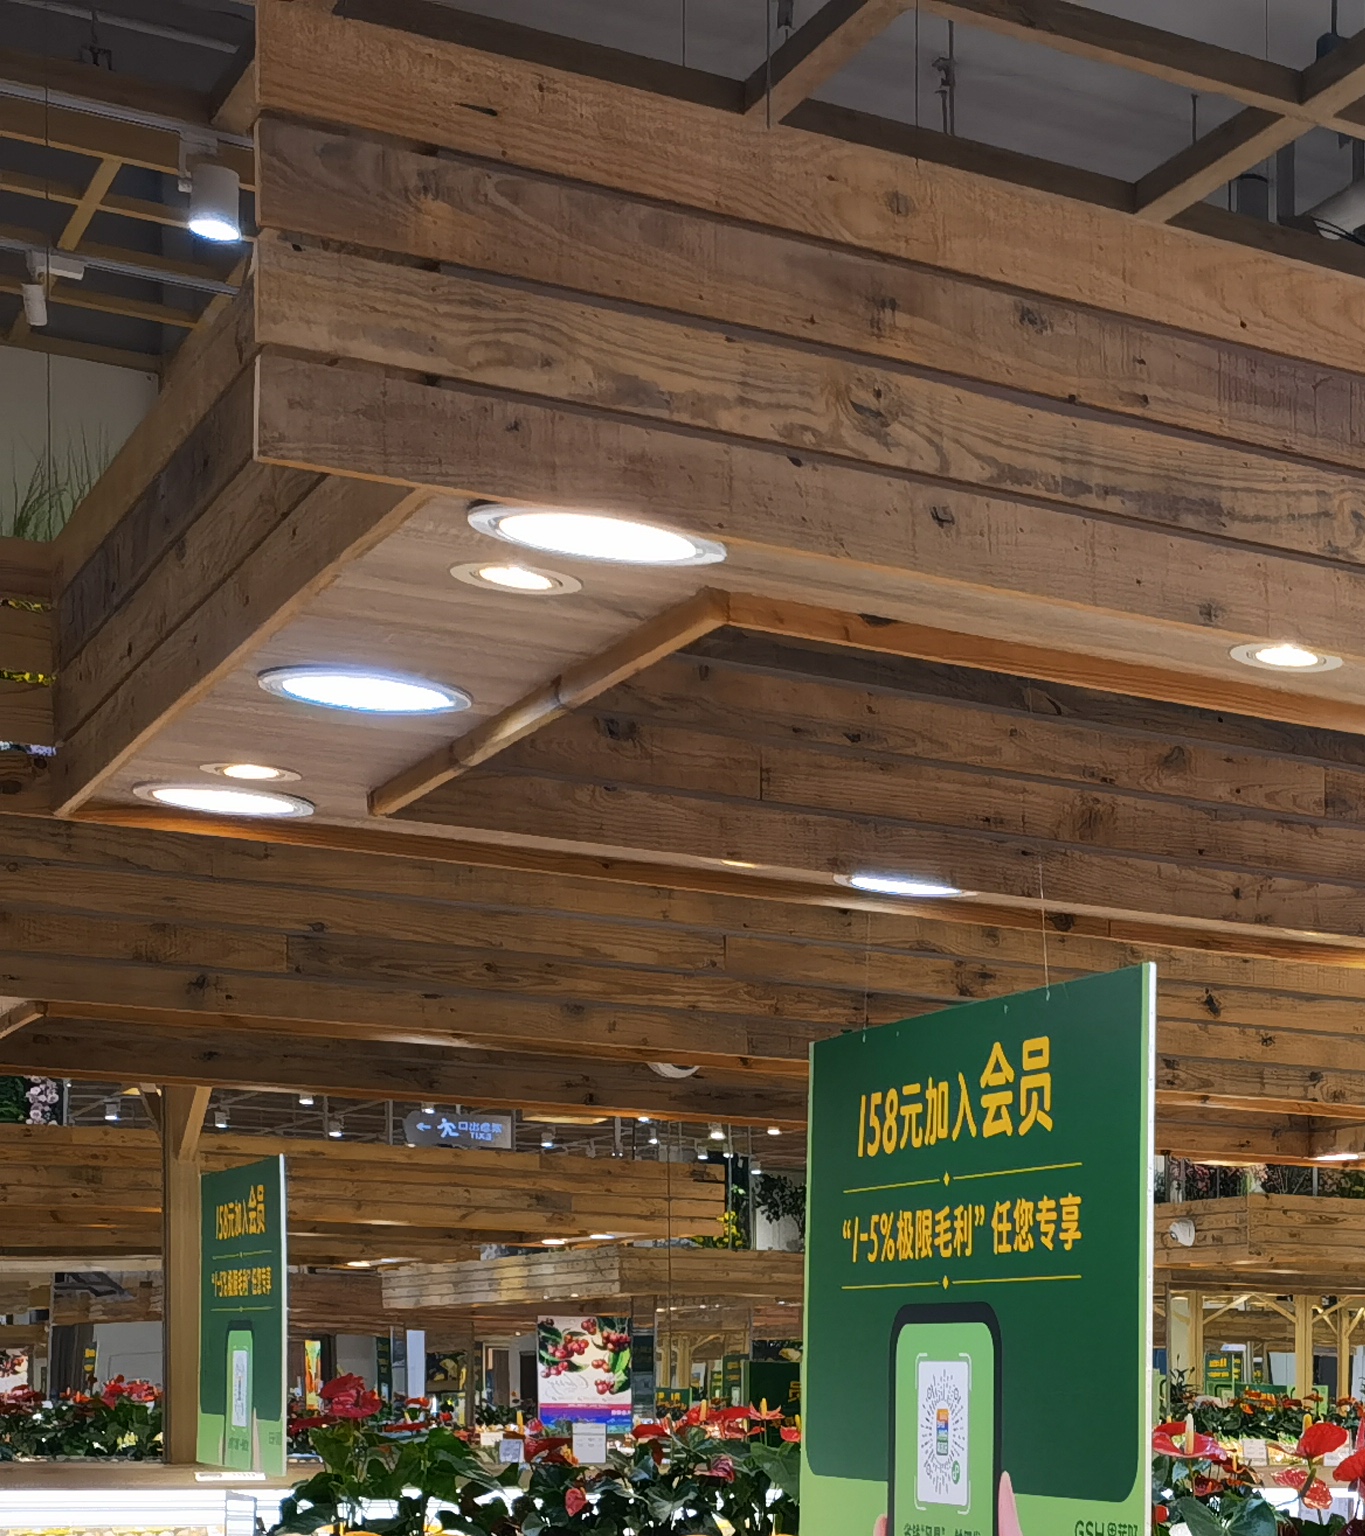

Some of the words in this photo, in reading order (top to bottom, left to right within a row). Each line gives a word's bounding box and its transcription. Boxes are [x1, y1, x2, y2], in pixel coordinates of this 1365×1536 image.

[857, 1035, 1054, 1158] 158元加入会员
[991, 1192, 1083, 1255] 任您专享
